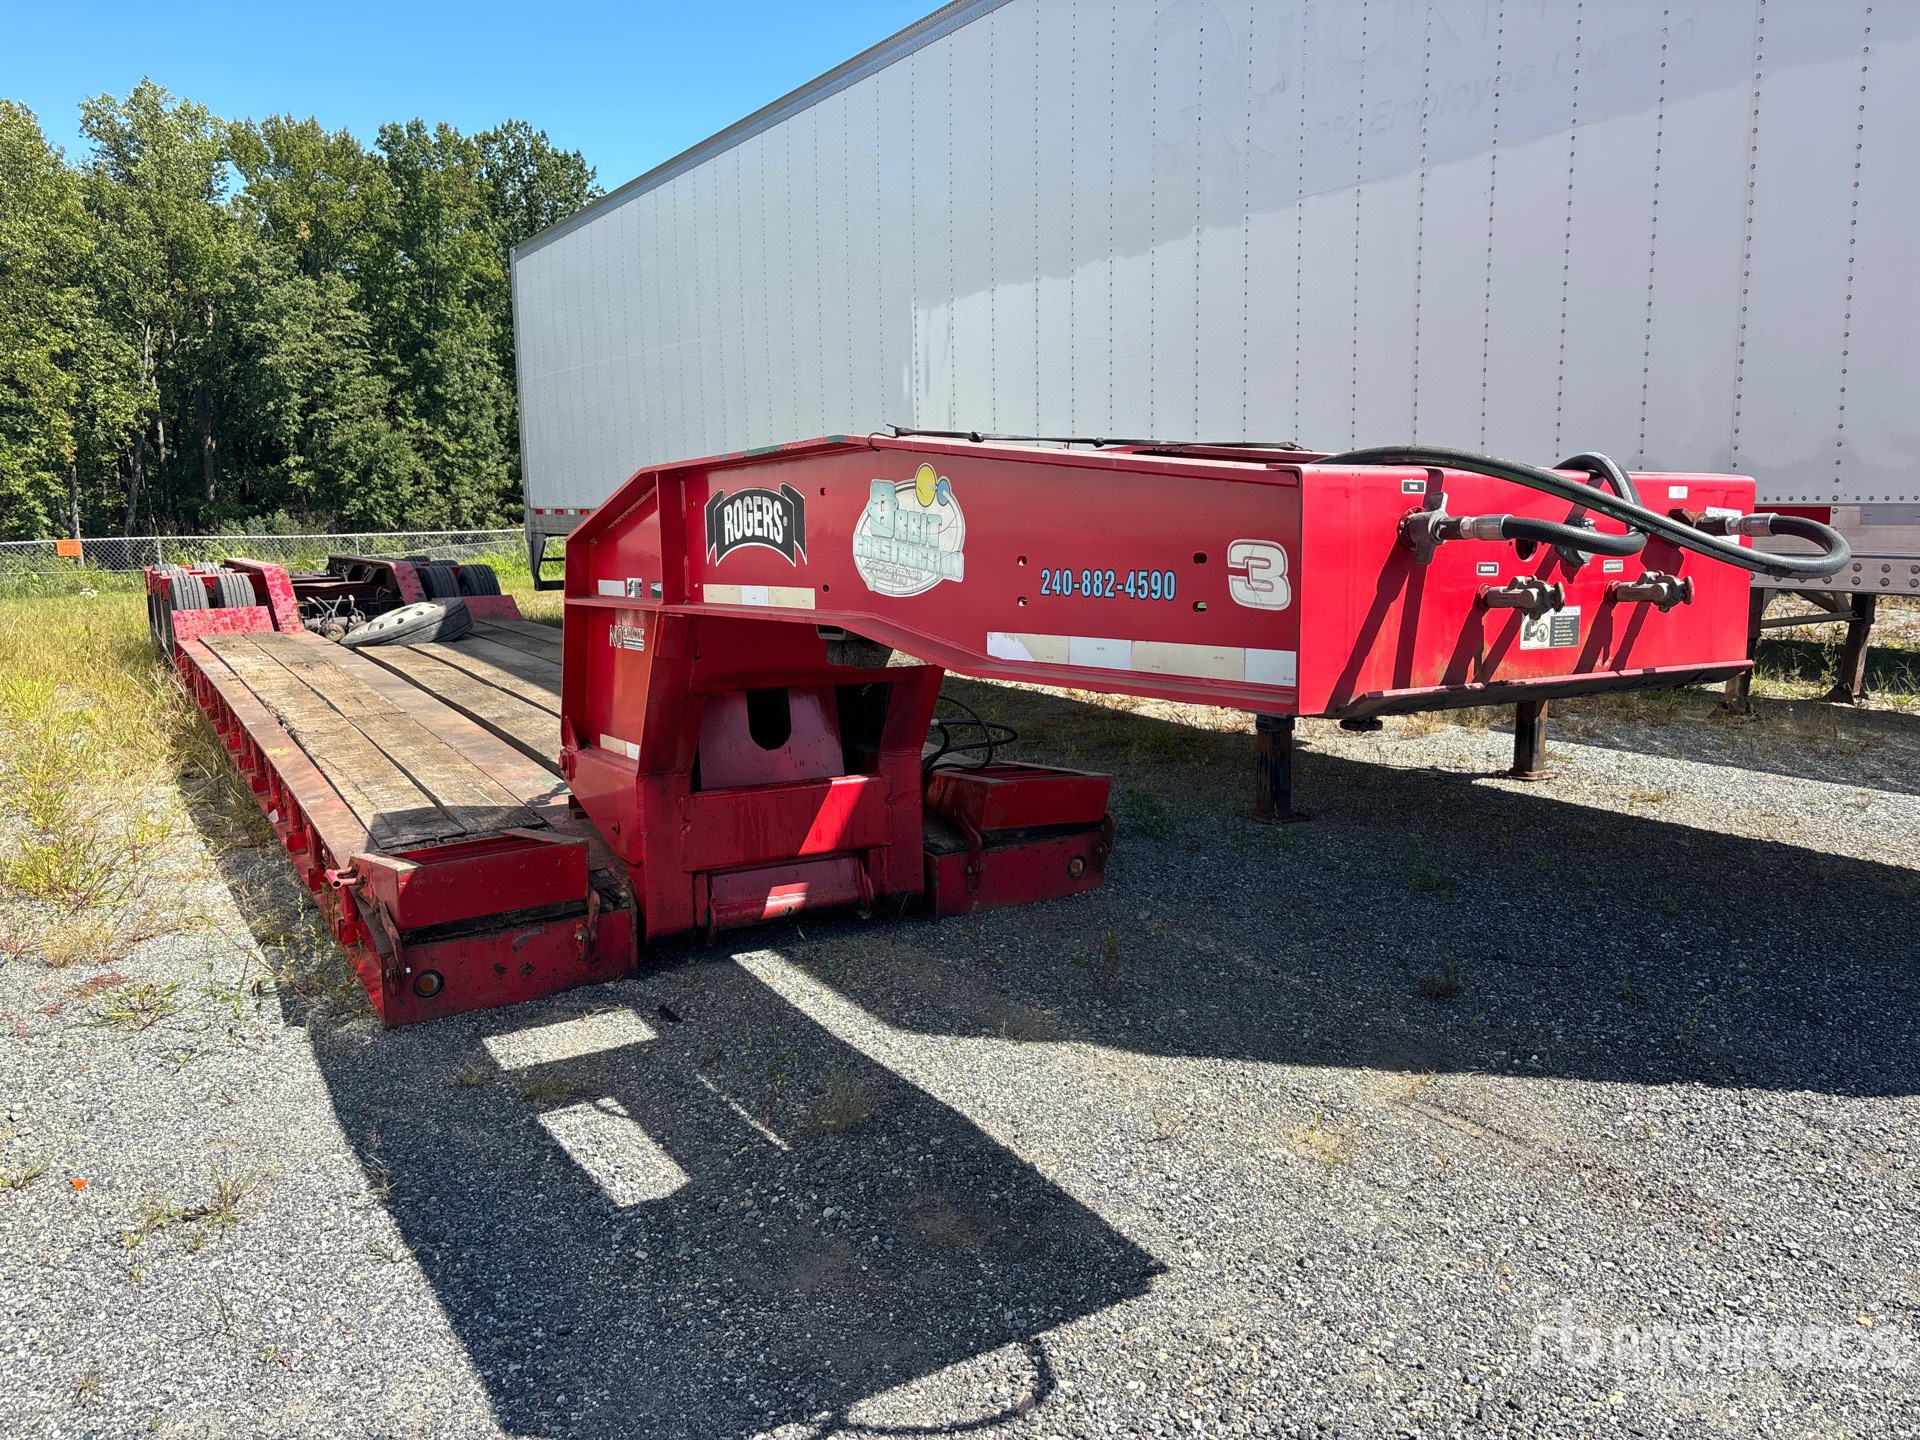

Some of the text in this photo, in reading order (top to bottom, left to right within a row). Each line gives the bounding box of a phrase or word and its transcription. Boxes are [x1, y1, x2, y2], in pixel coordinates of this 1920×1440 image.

[868, 480, 943, 548] ORBIT
[854, 534, 964, 580] CONSTRUCTION
[1040, 568, 1177, 602] 240-882-4590
[1227, 539, 1292, 610] 3
